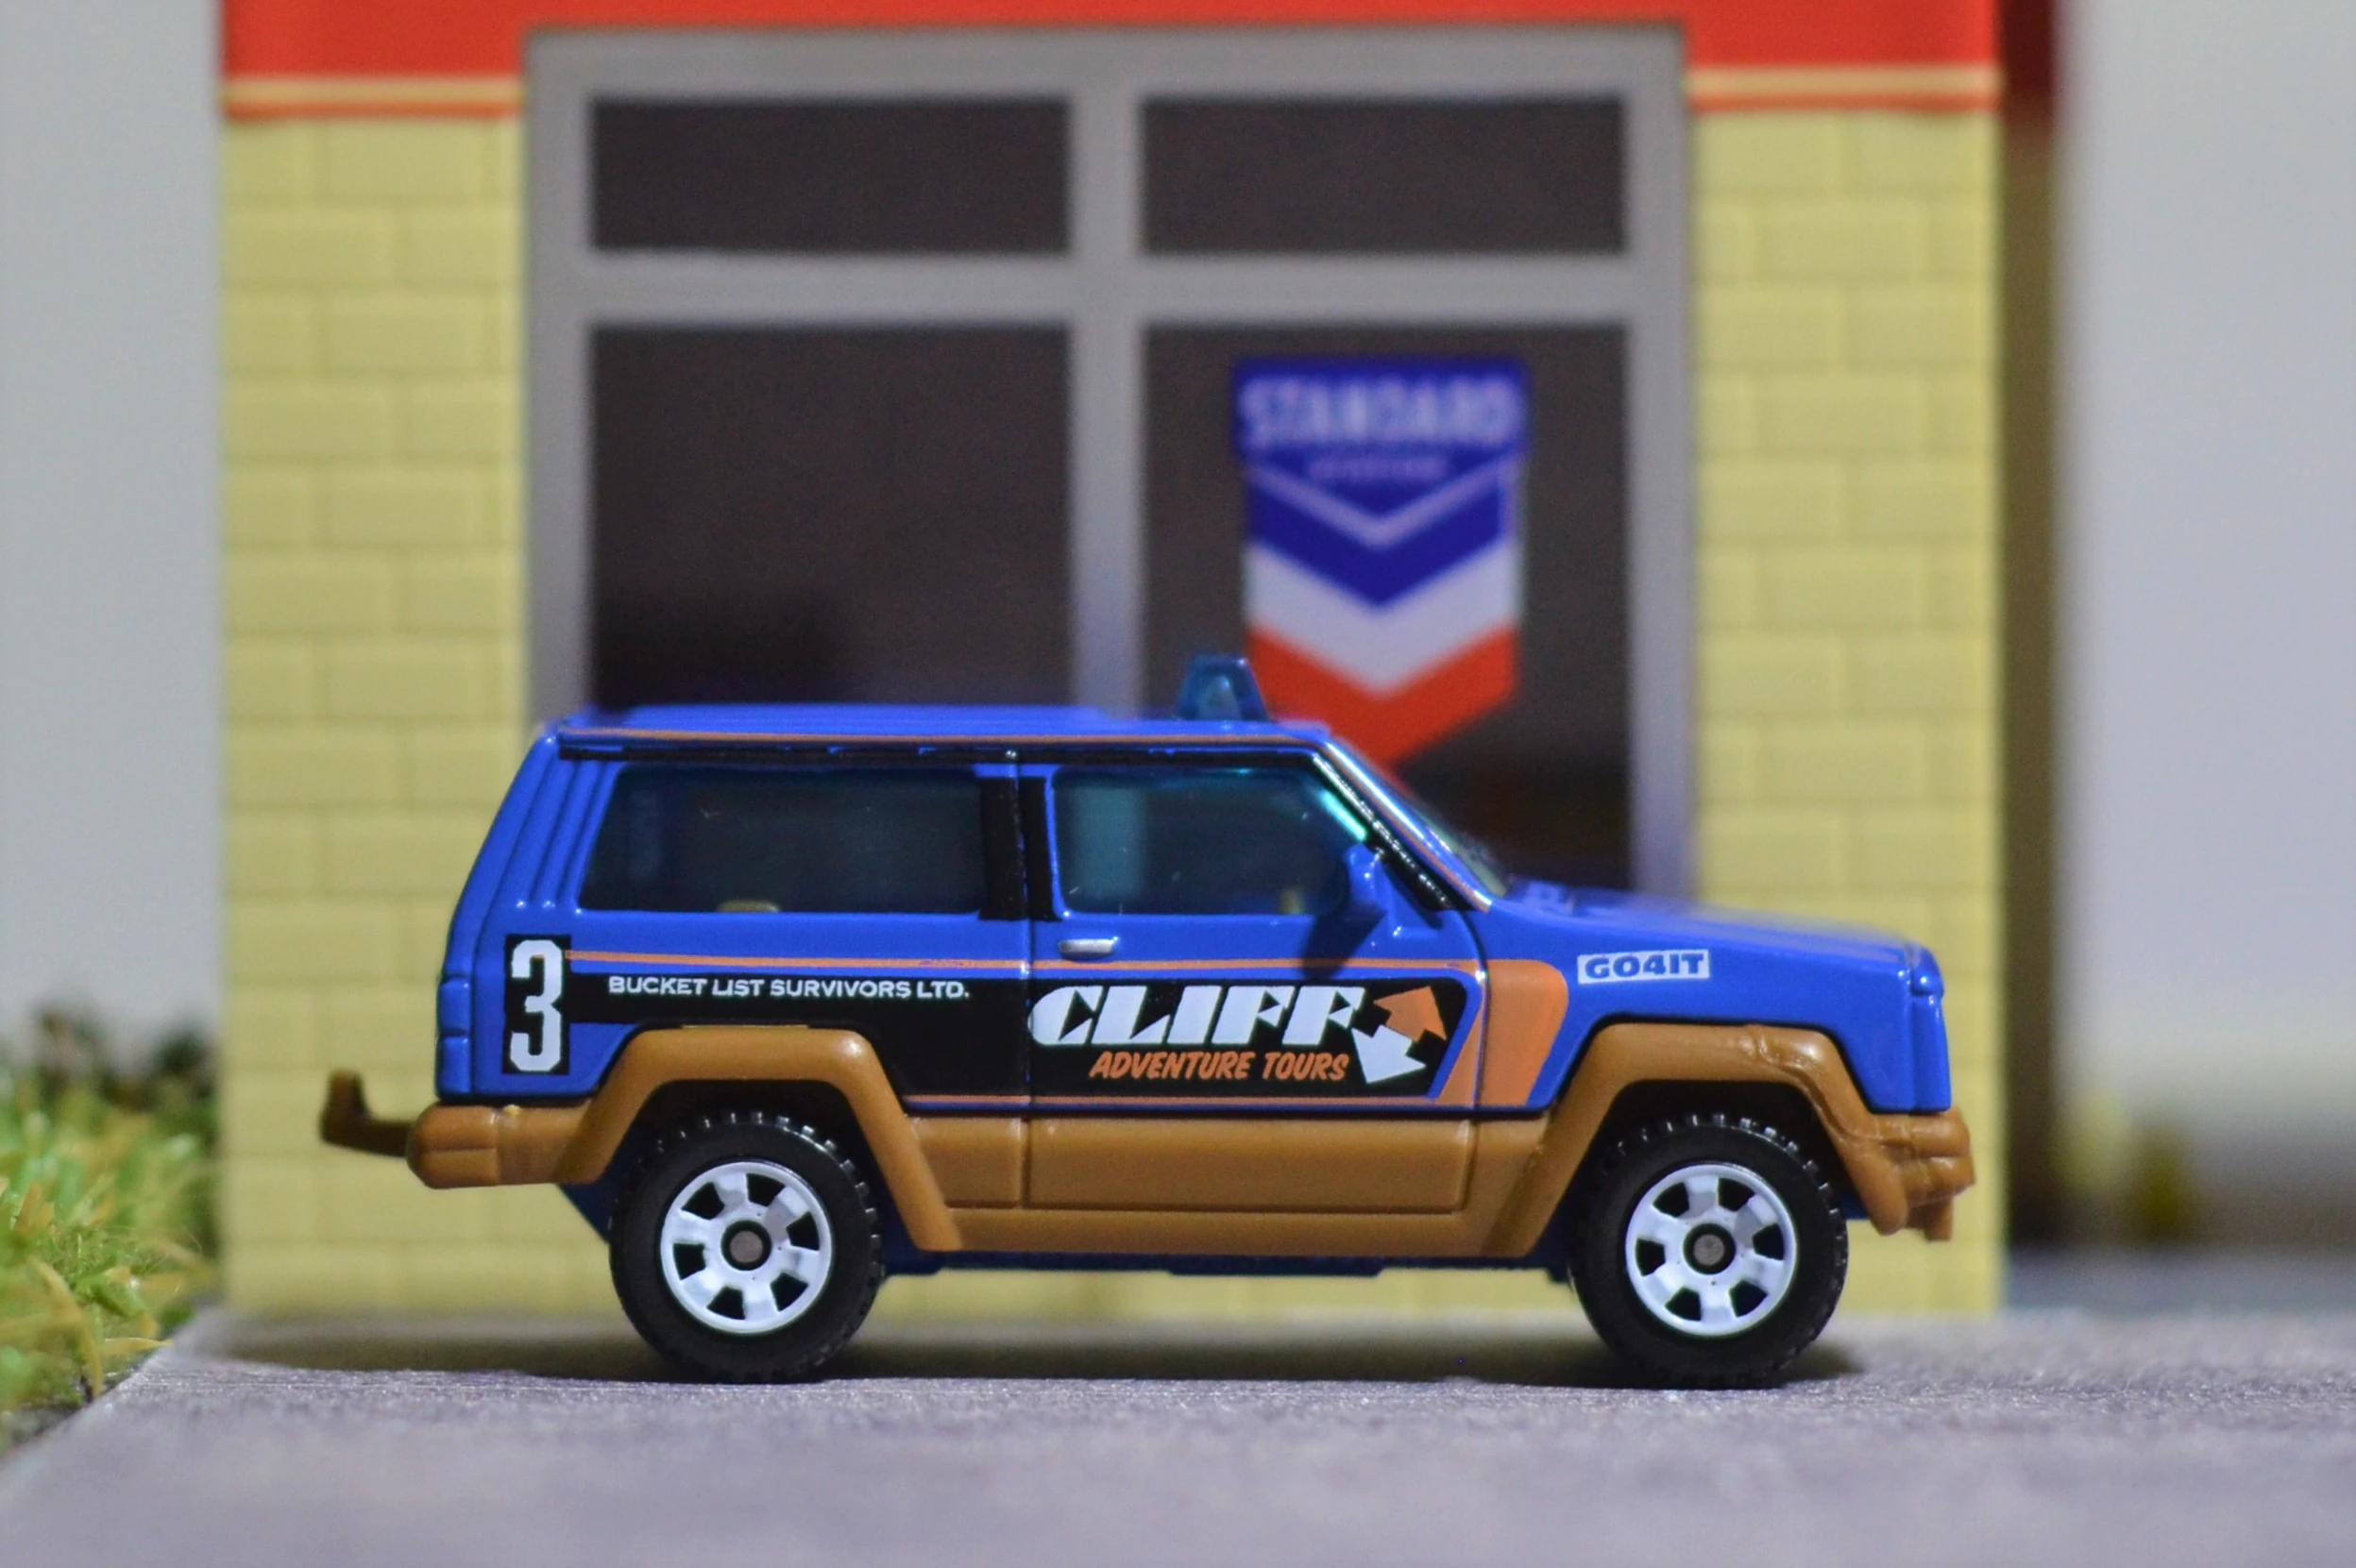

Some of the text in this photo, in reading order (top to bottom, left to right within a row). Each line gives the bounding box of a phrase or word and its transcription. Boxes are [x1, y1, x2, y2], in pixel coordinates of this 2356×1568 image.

[1585, 953, 1703, 979] GO4IT
[608, 975, 970, 1000] BUCKET LIST SURVIVORS LTD.
[509, 939, 564, 1072] 3
[1028, 985, 1365, 1045] CLIFF
[1089, 1051, 1349, 1082] ADVENTURE TOURS
